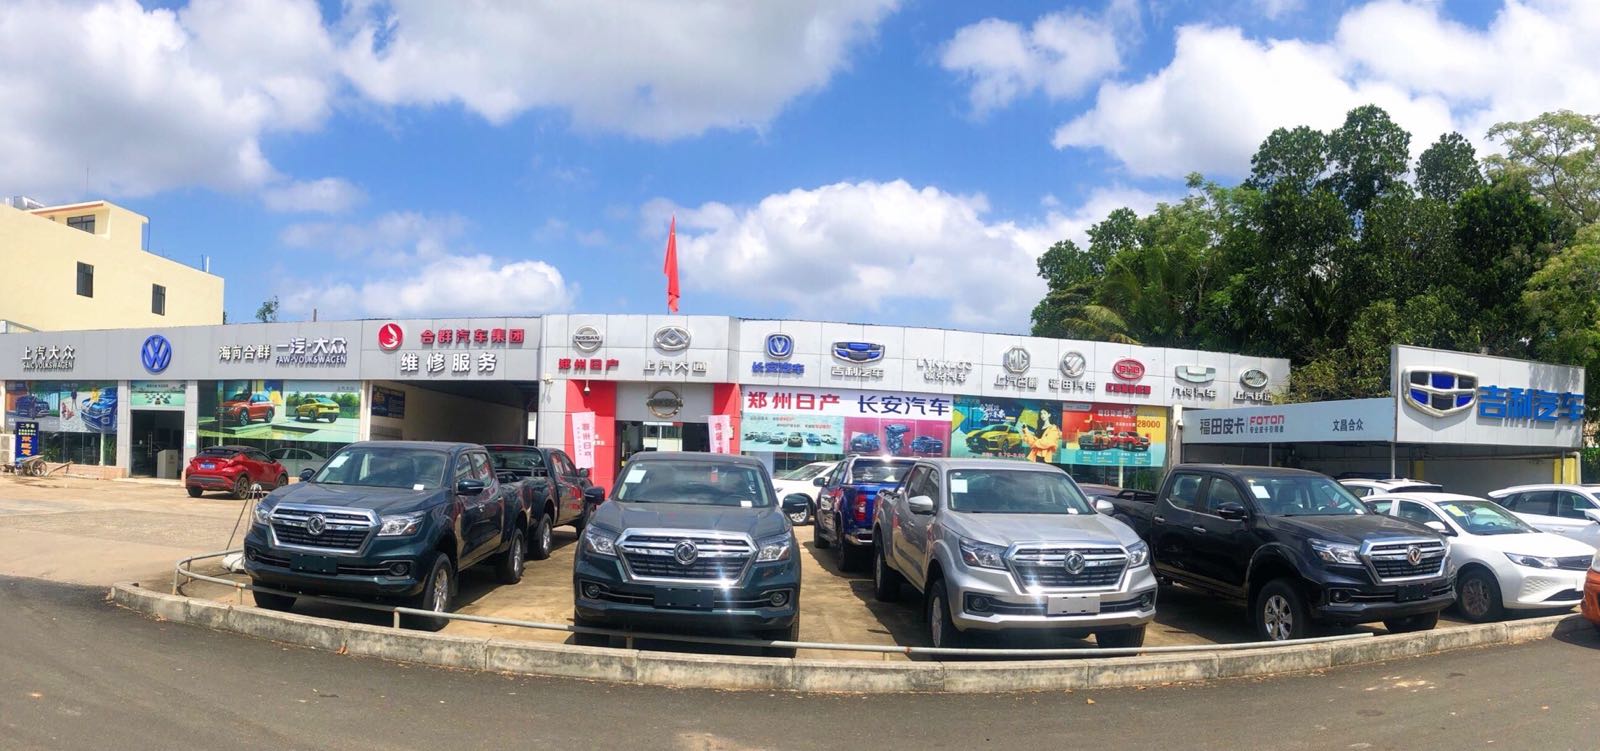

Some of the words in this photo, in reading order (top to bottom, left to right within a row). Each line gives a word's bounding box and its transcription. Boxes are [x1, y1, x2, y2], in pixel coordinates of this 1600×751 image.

[421, 328, 526, 346] 合群汽车集团
[21, 345, 75, 361] 上汽大众
[219, 344, 271, 361] 海南合群
[1006, 351, 1029, 369] MG
[36, 361, 74, 370] VOLKSWAGEN
[400, 352, 497, 373] 维修服务
[558, 358, 620, 371] 郑州日产
[644, 360, 708, 373] 上汽大通
[752, 361, 805, 376] 长安汽车
[1118, 365, 1140, 374] BYD
[831, 366, 884, 380] 吉利汽车
[1048, 378, 1096, 392] 福田汽车
[748, 391, 841, 411] 郑州日产
[857, 394, 951, 416] 长安汽车
[1477, 384, 1585, 423] 吉利汽车
[1136, 419, 1161, 428] 28000
[1199, 417, 1245, 435] 福田皮卡
[1249, 415, 1285, 426] FOTON
[1332, 418, 1364, 432] 文昌合众
